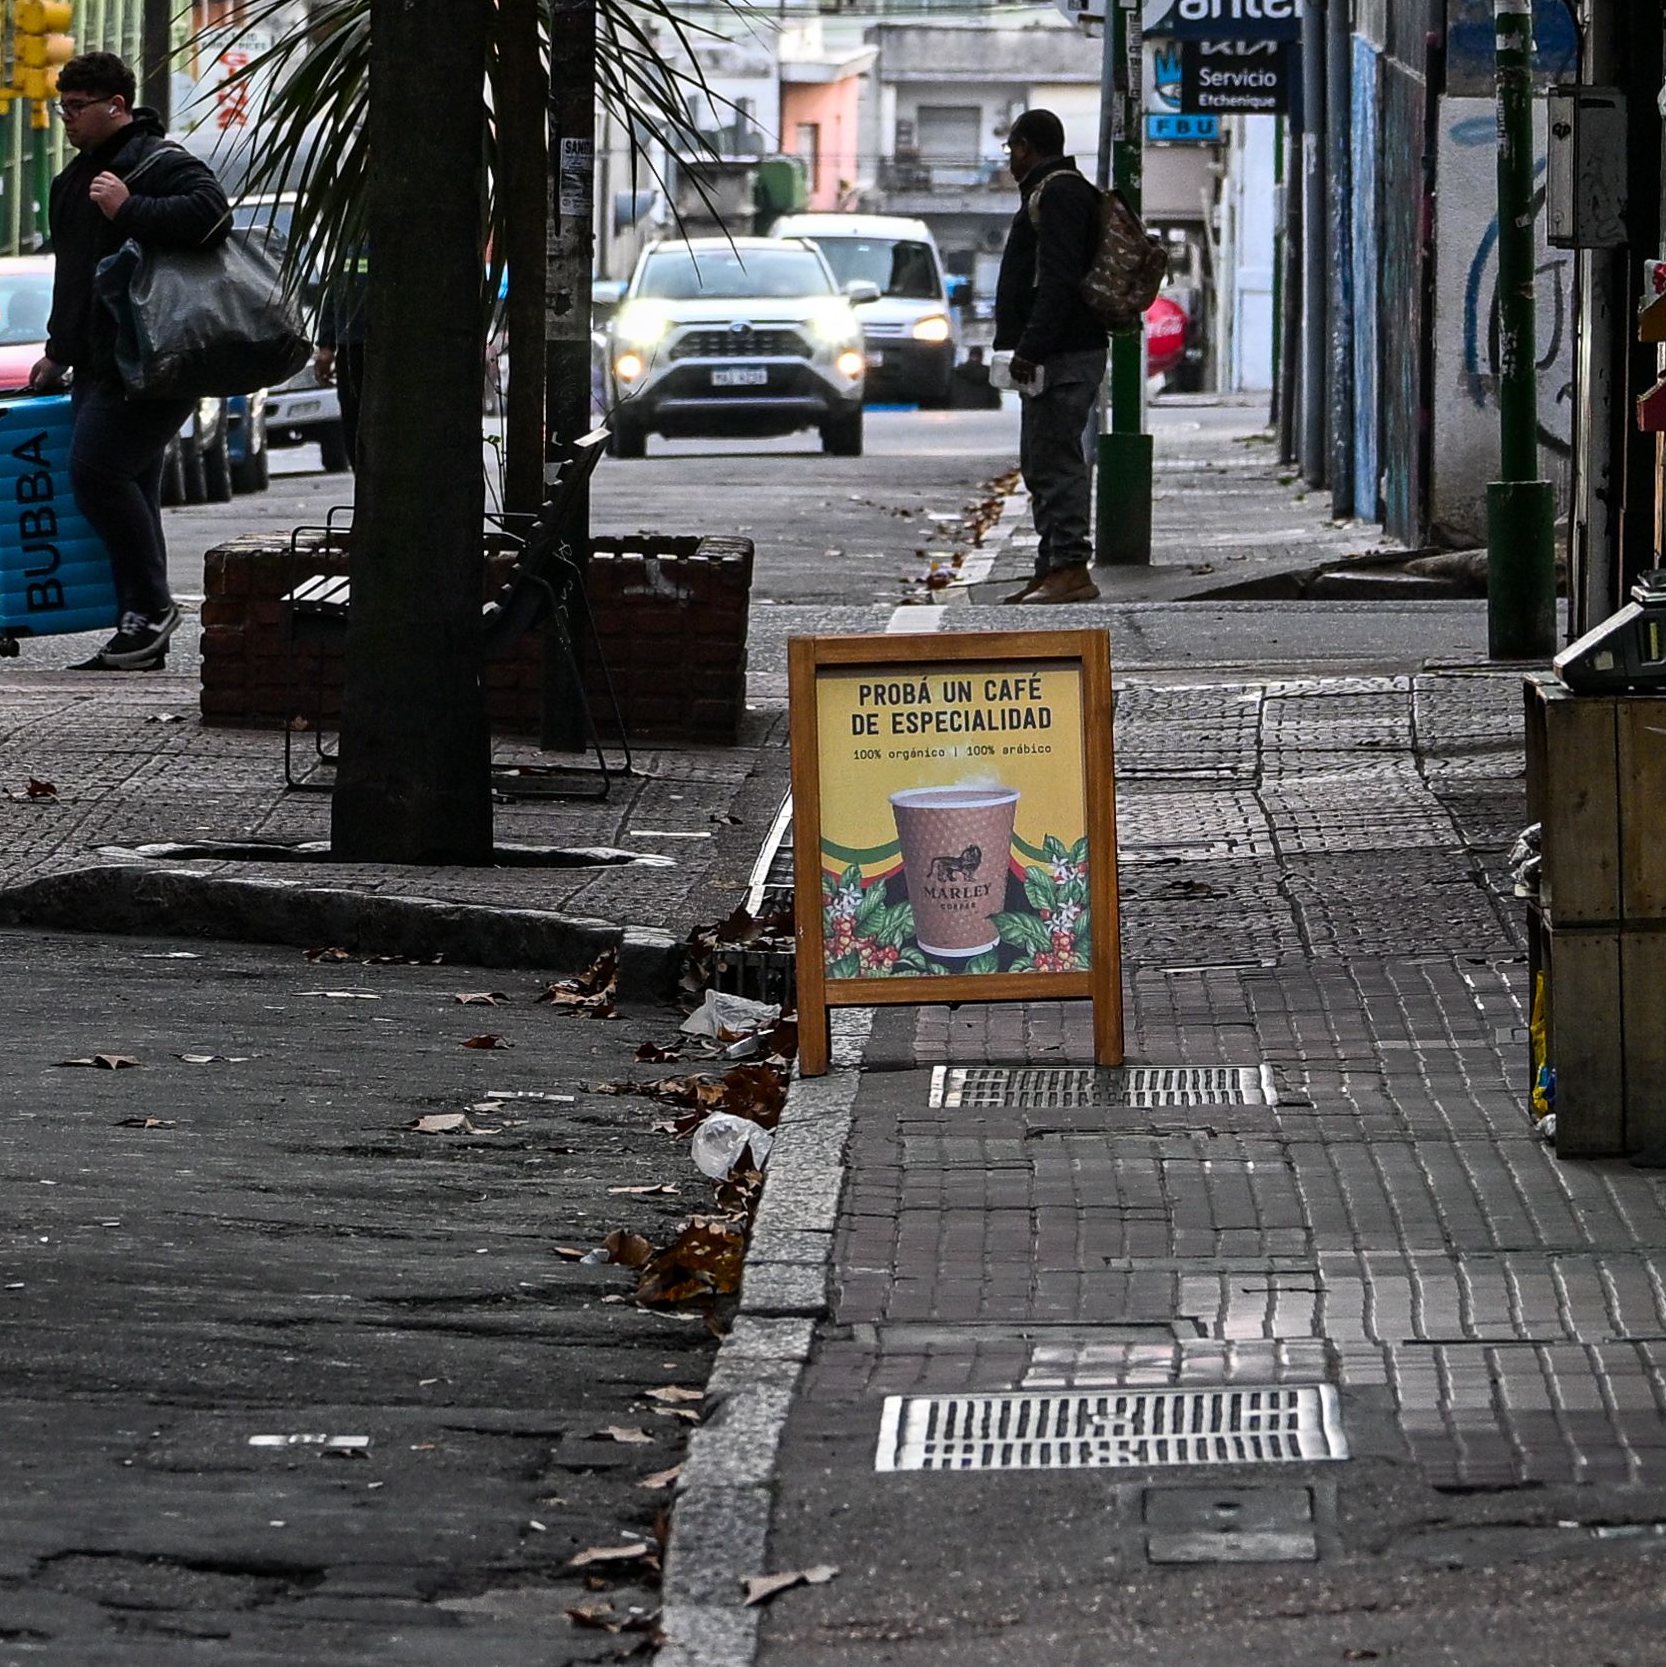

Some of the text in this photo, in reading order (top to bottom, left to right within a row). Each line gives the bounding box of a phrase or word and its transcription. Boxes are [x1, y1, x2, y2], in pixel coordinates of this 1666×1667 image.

[1199, 68, 1278, 87] Servicio
[11, 431, 65, 612] BUBBA
[859, 672, 1042, 706] PROBÁ UN CAFÉ
[852, 707, 1052, 735] DE ESPECIALIDAD
[853, 749, 881, 760] 100%
[889, 747, 945, 761] orgánico
[966, 745, 995, 756] 100%
[924, 882, 992, 899] MARLEY
